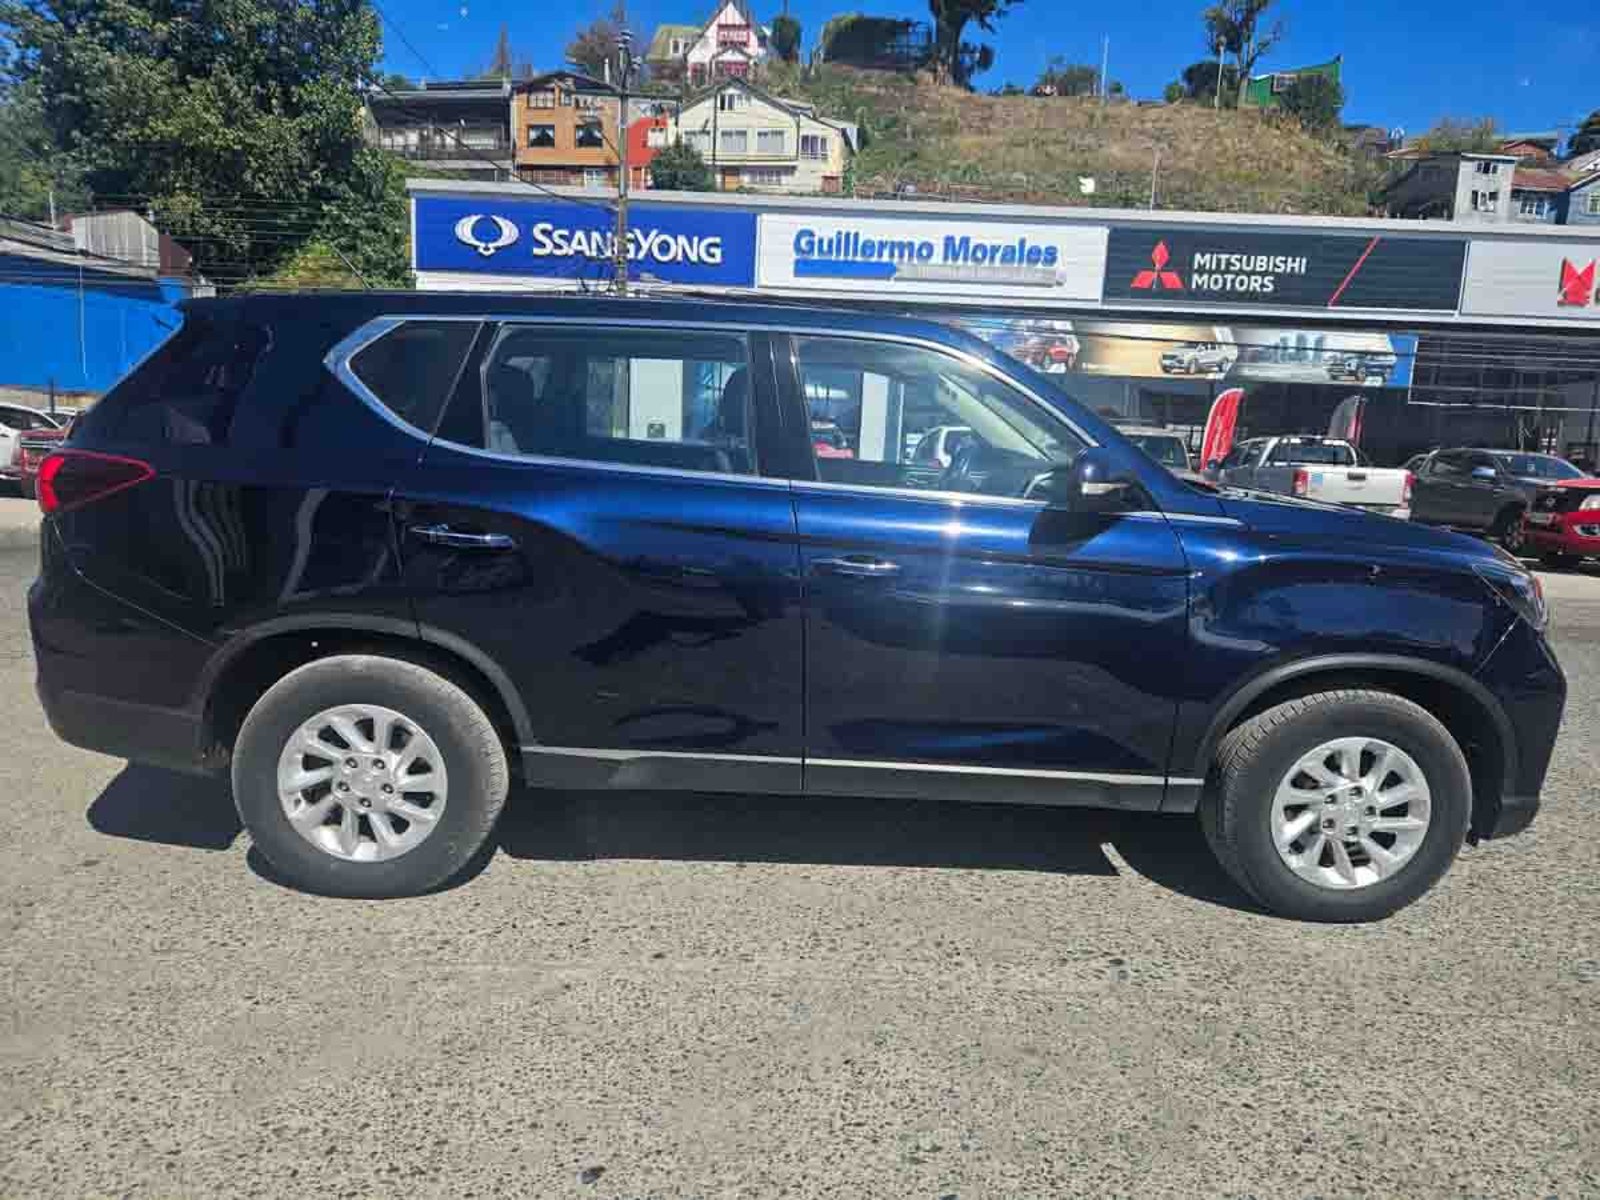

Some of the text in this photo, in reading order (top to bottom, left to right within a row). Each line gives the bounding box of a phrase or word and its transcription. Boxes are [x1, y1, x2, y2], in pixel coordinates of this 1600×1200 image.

[793, 228, 1059, 267] Guillermo Morales
[1194, 252, 1307, 274] MITSUBISHI
[1191, 273, 1275, 292] MOTORS
